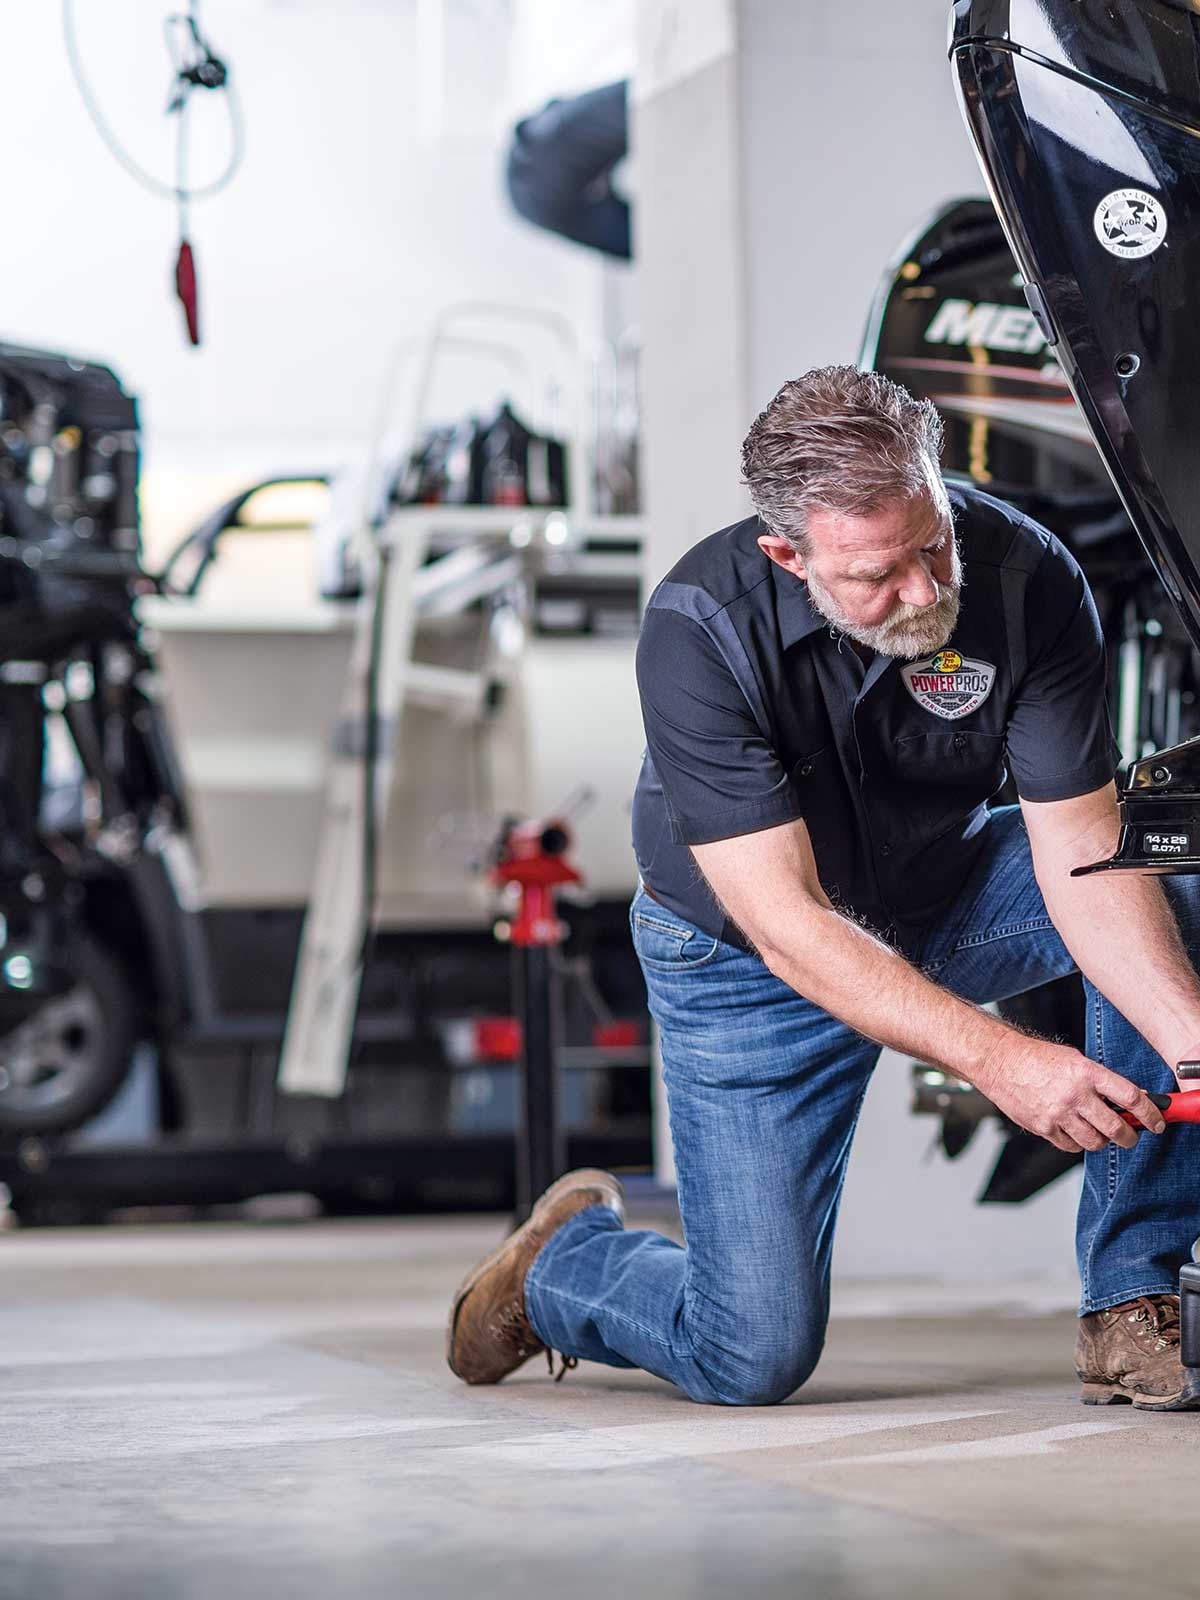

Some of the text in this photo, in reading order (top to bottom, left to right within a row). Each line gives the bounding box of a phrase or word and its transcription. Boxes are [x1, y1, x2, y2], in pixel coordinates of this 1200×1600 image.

[1135, 192, 1156, 206] LOW
[920, 697, 979, 718] SERVICE CENTER
[1146, 835, 1162, 844] 14
[1170, 836, 1187, 845] 29
[1151, 844, 1181, 853] 2.07:1
